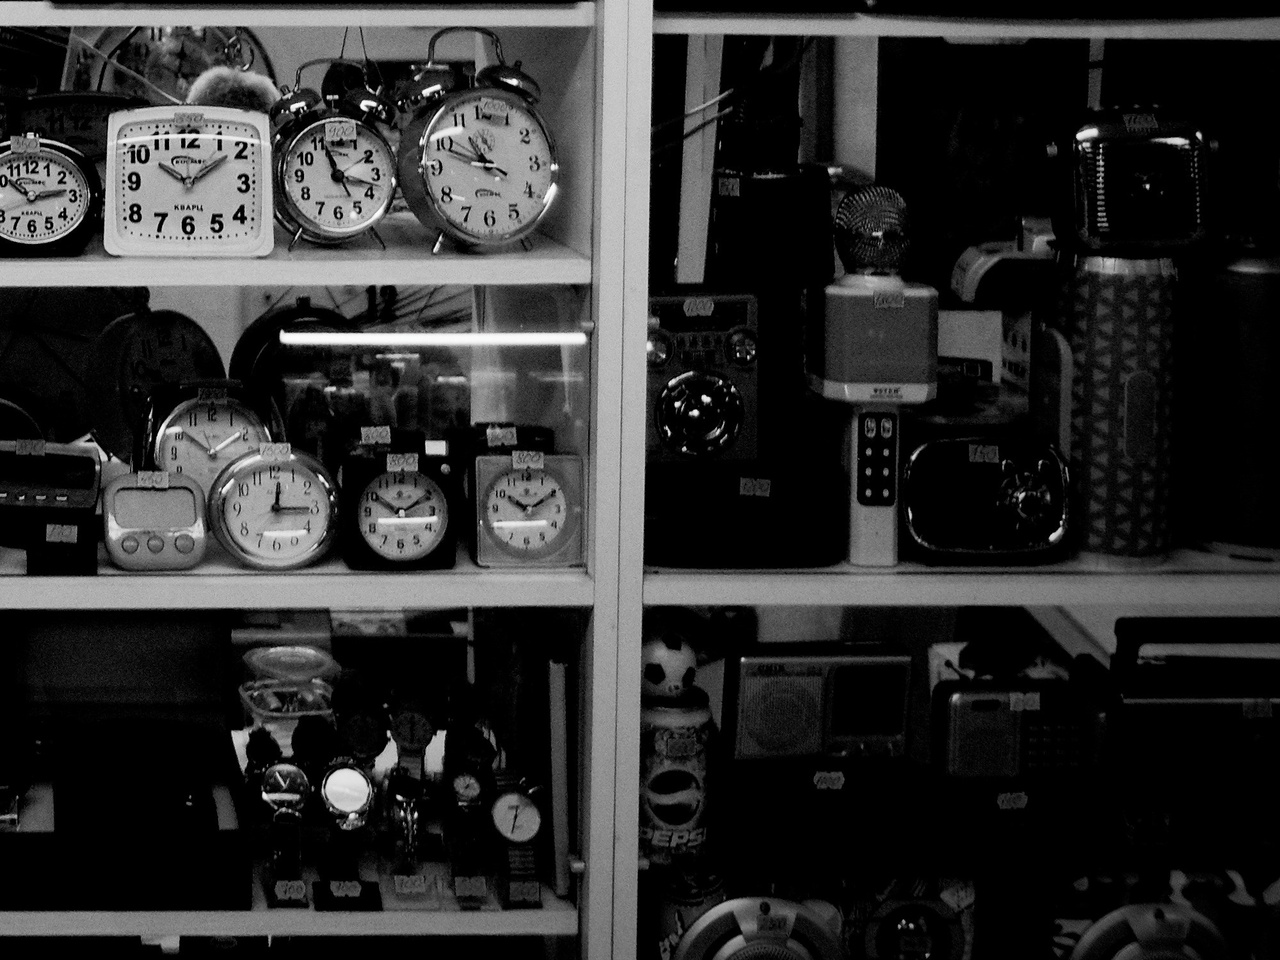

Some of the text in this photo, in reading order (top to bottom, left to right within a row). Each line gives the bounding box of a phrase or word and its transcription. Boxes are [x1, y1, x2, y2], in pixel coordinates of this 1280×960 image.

[453, 113, 466, 128] 11
[504, 113, 510, 126] 1
[151, 131, 170, 151] 11
[180, 129, 201, 150] 12
[215, 131, 223, 151] 1
[311, 137, 325, 151] 11
[436, 136, 453, 152] 10
[519, 129, 530, 144] 2
[234, 141, 249, 160] 2
[352, 140, 357, 150] 1
[127, 144, 151, 164] 10
[297, 152, 314, 166] 10
[364, 150, 373, 164] 2
[7, 163, 20, 177] 11
[22, 160, 39, 174] 12
[43, 163, 50, 177] 1
[431, 159, 444, 176] 9
[530, 155, 540, 172] 3
[57, 171, 67, 185] 2
[127, 172, 141, 191] 9
[294, 169, 305, 183] 9
[371, 168, 381, 182] 3
[237, 174, 251, 194] 3
[524, 182, 535, 198] 4
[69, 189, 78, 203] 3
[301, 187, 311, 201] 8
[364, 186, 375, 200] 4
[441, 186, 453, 203] 8
[58, 207, 68, 221] 4
[129, 203, 142, 224] 8
[232, 204, 247, 225] 4
[315, 201, 326, 215] 7
[333, 206, 343, 220] 6
[352, 201, 362, 215] 5
[461, 206, 472, 223] 7
[509, 204, 520, 220] 5
[11, 217, 21, 231] 7
[27, 219, 37, 233] 6
[44, 216, 54, 231] 5
[154, 212, 168, 233] 7
[181, 215, 195, 235] 6
[210, 214, 224, 233] 5
[484, 210, 496, 227] 6
